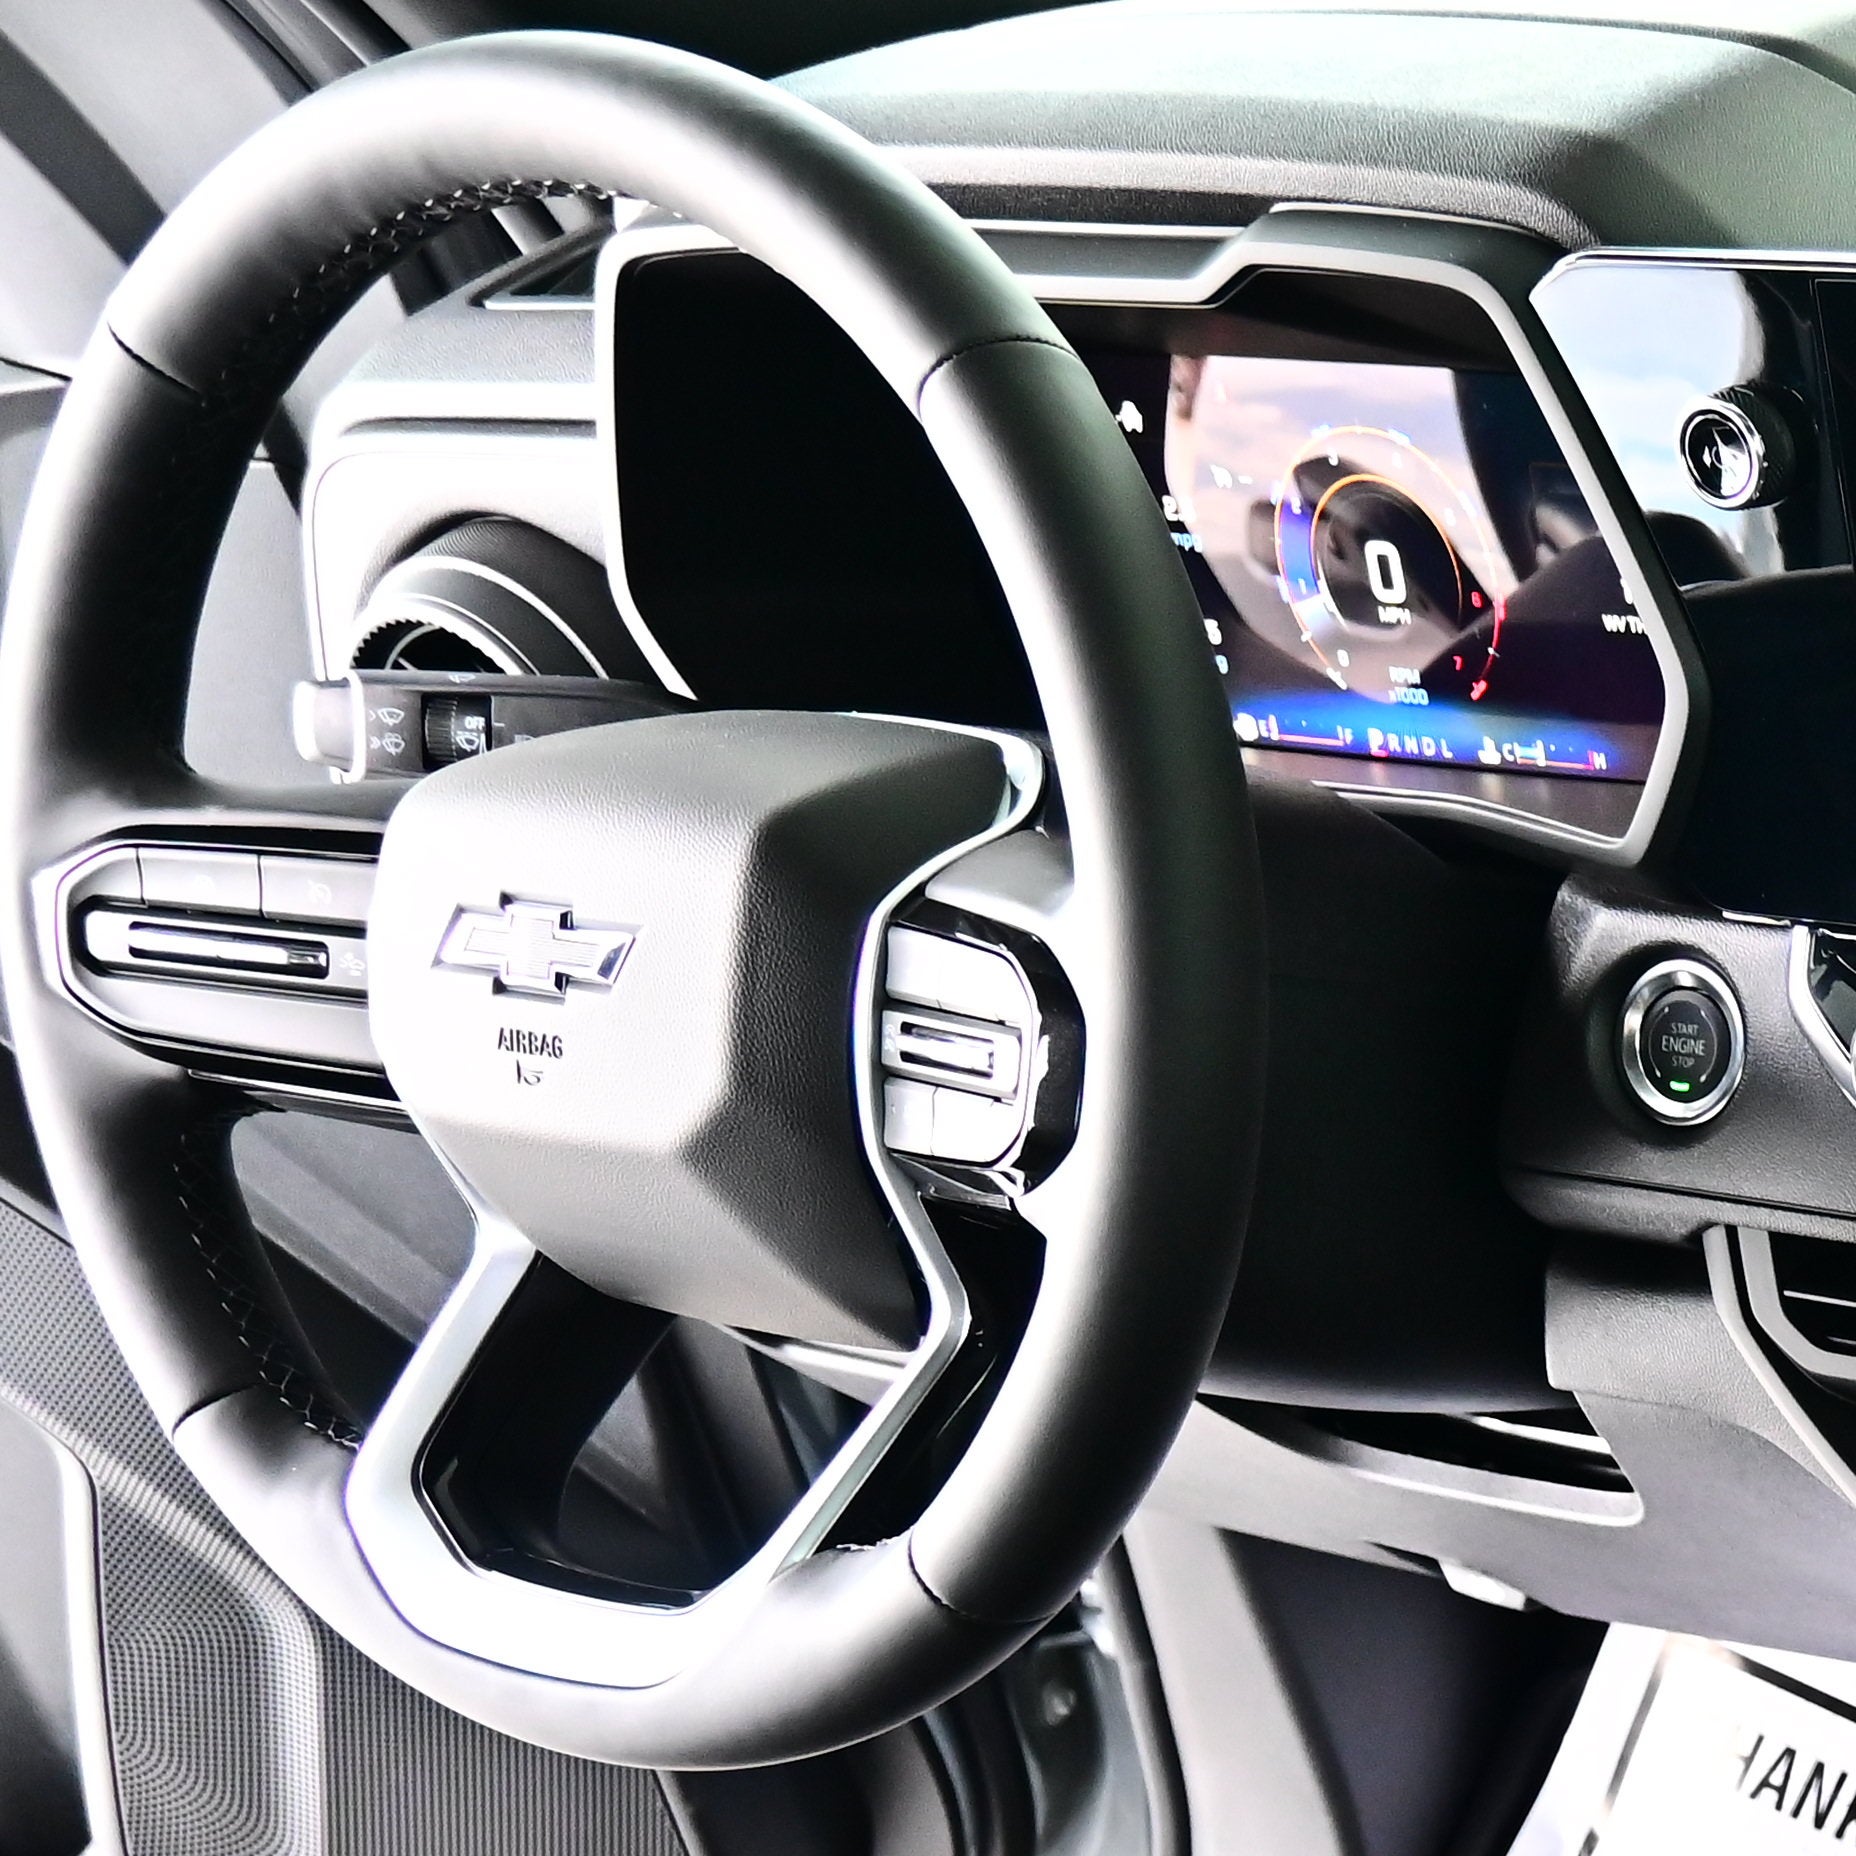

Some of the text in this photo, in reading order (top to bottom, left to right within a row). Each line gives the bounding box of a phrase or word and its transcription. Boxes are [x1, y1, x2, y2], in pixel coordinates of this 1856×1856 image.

[1364, 539, 1408, 604] 0
[1378, 606, 1412, 626] MPH
[1389, 666, 1421, 685] RPM
[1367, 728, 1453, 758] P R N D L
[1671, 1023, 1699, 1036] START
[498, 1027, 563, 1059] AIRBAG
[1661, 1036, 1706, 1056] ENGINE
[1671, 1056, 1695, 1067] STOP
